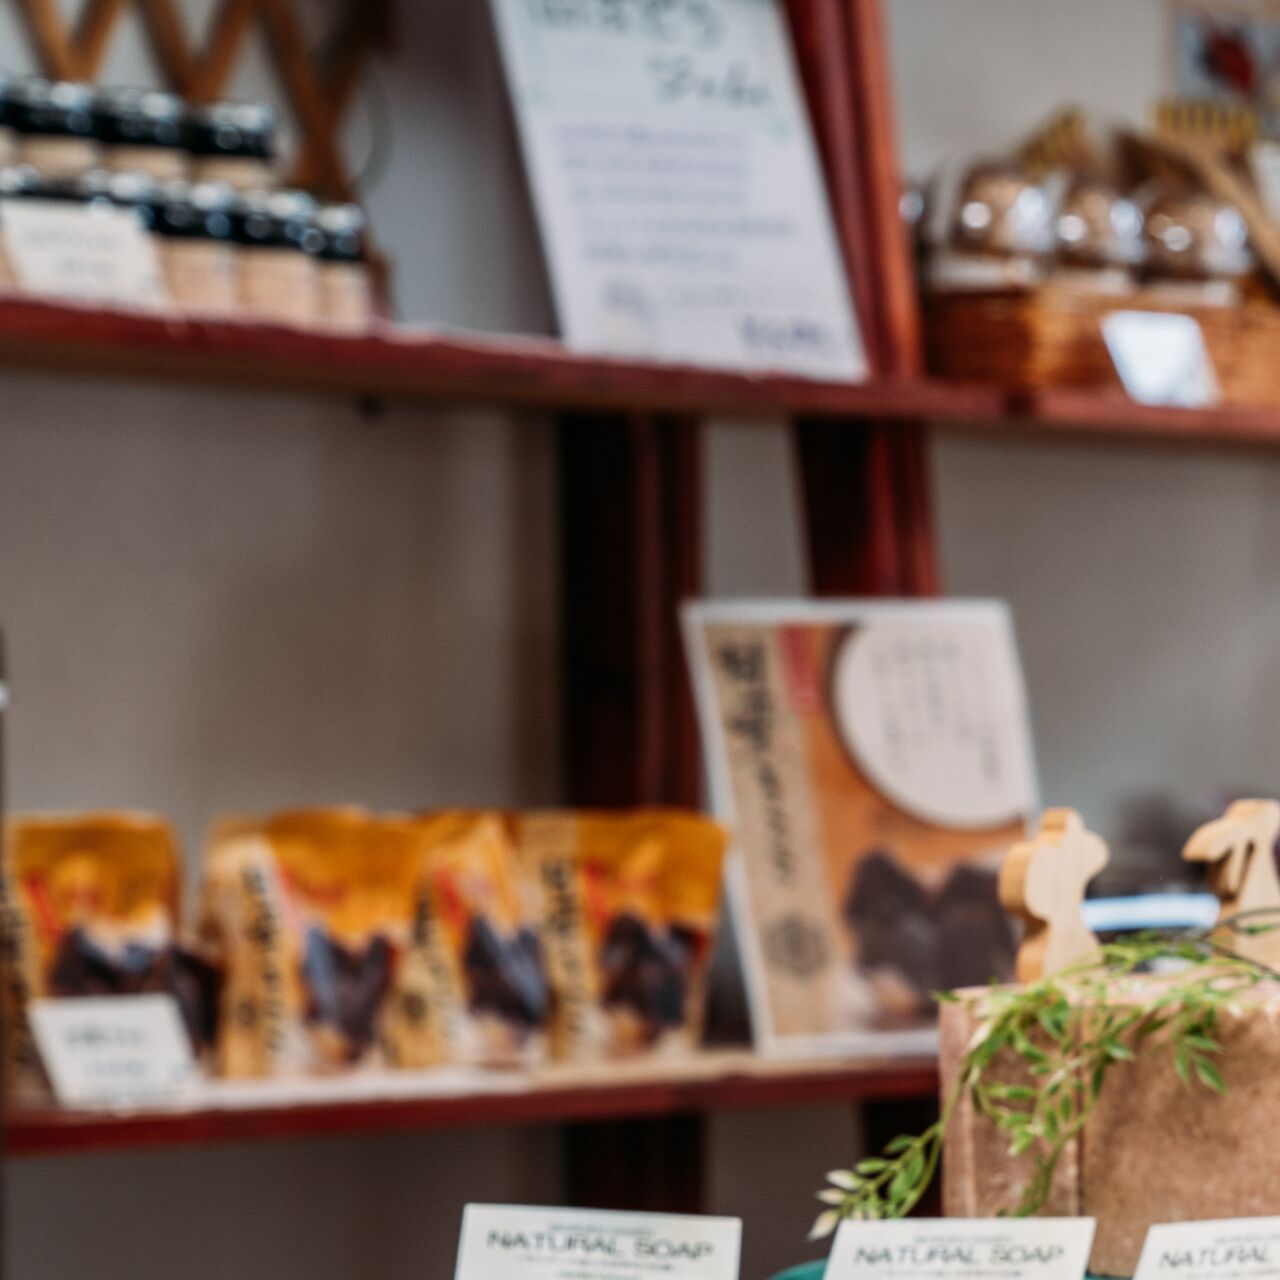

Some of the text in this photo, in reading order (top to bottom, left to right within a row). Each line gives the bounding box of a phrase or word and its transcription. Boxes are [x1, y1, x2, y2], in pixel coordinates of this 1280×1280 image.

[485, 1229, 621, 1257] NATURAL
[853, 1244, 978, 1266] NATURAL
[1157, 1244, 1272, 1269] NATURAL
